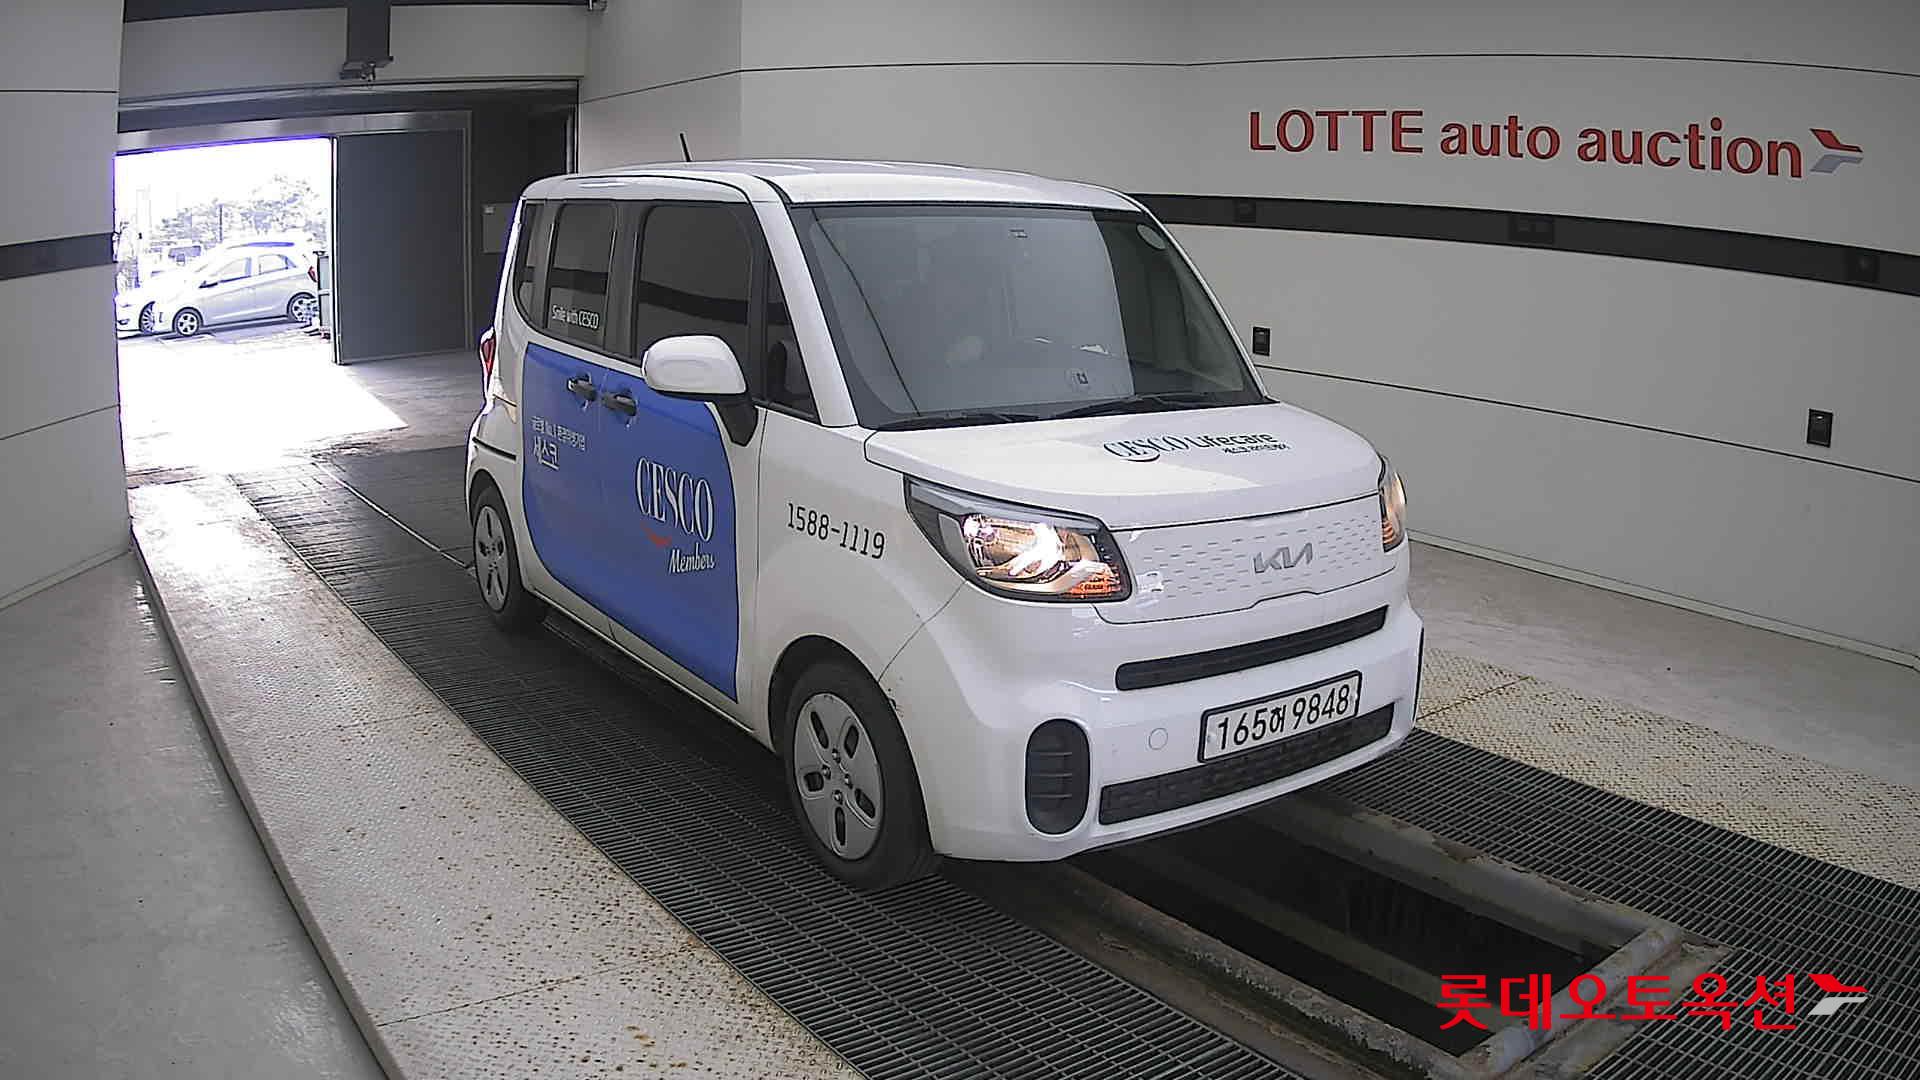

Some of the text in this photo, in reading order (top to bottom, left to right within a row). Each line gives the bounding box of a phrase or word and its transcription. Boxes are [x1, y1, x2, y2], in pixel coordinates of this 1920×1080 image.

[1248, 108, 1804, 179] LOTTE auto auction
[578, 309, 600, 329] CESCO
[533, 436, 560, 470] 세스코
[1104, 433, 1279, 458] CESCO Lifecare
[636, 457, 715, 543] CESCO
[787, 502, 886, 560] 1588-1119
[669, 543, 716, 574] Members
